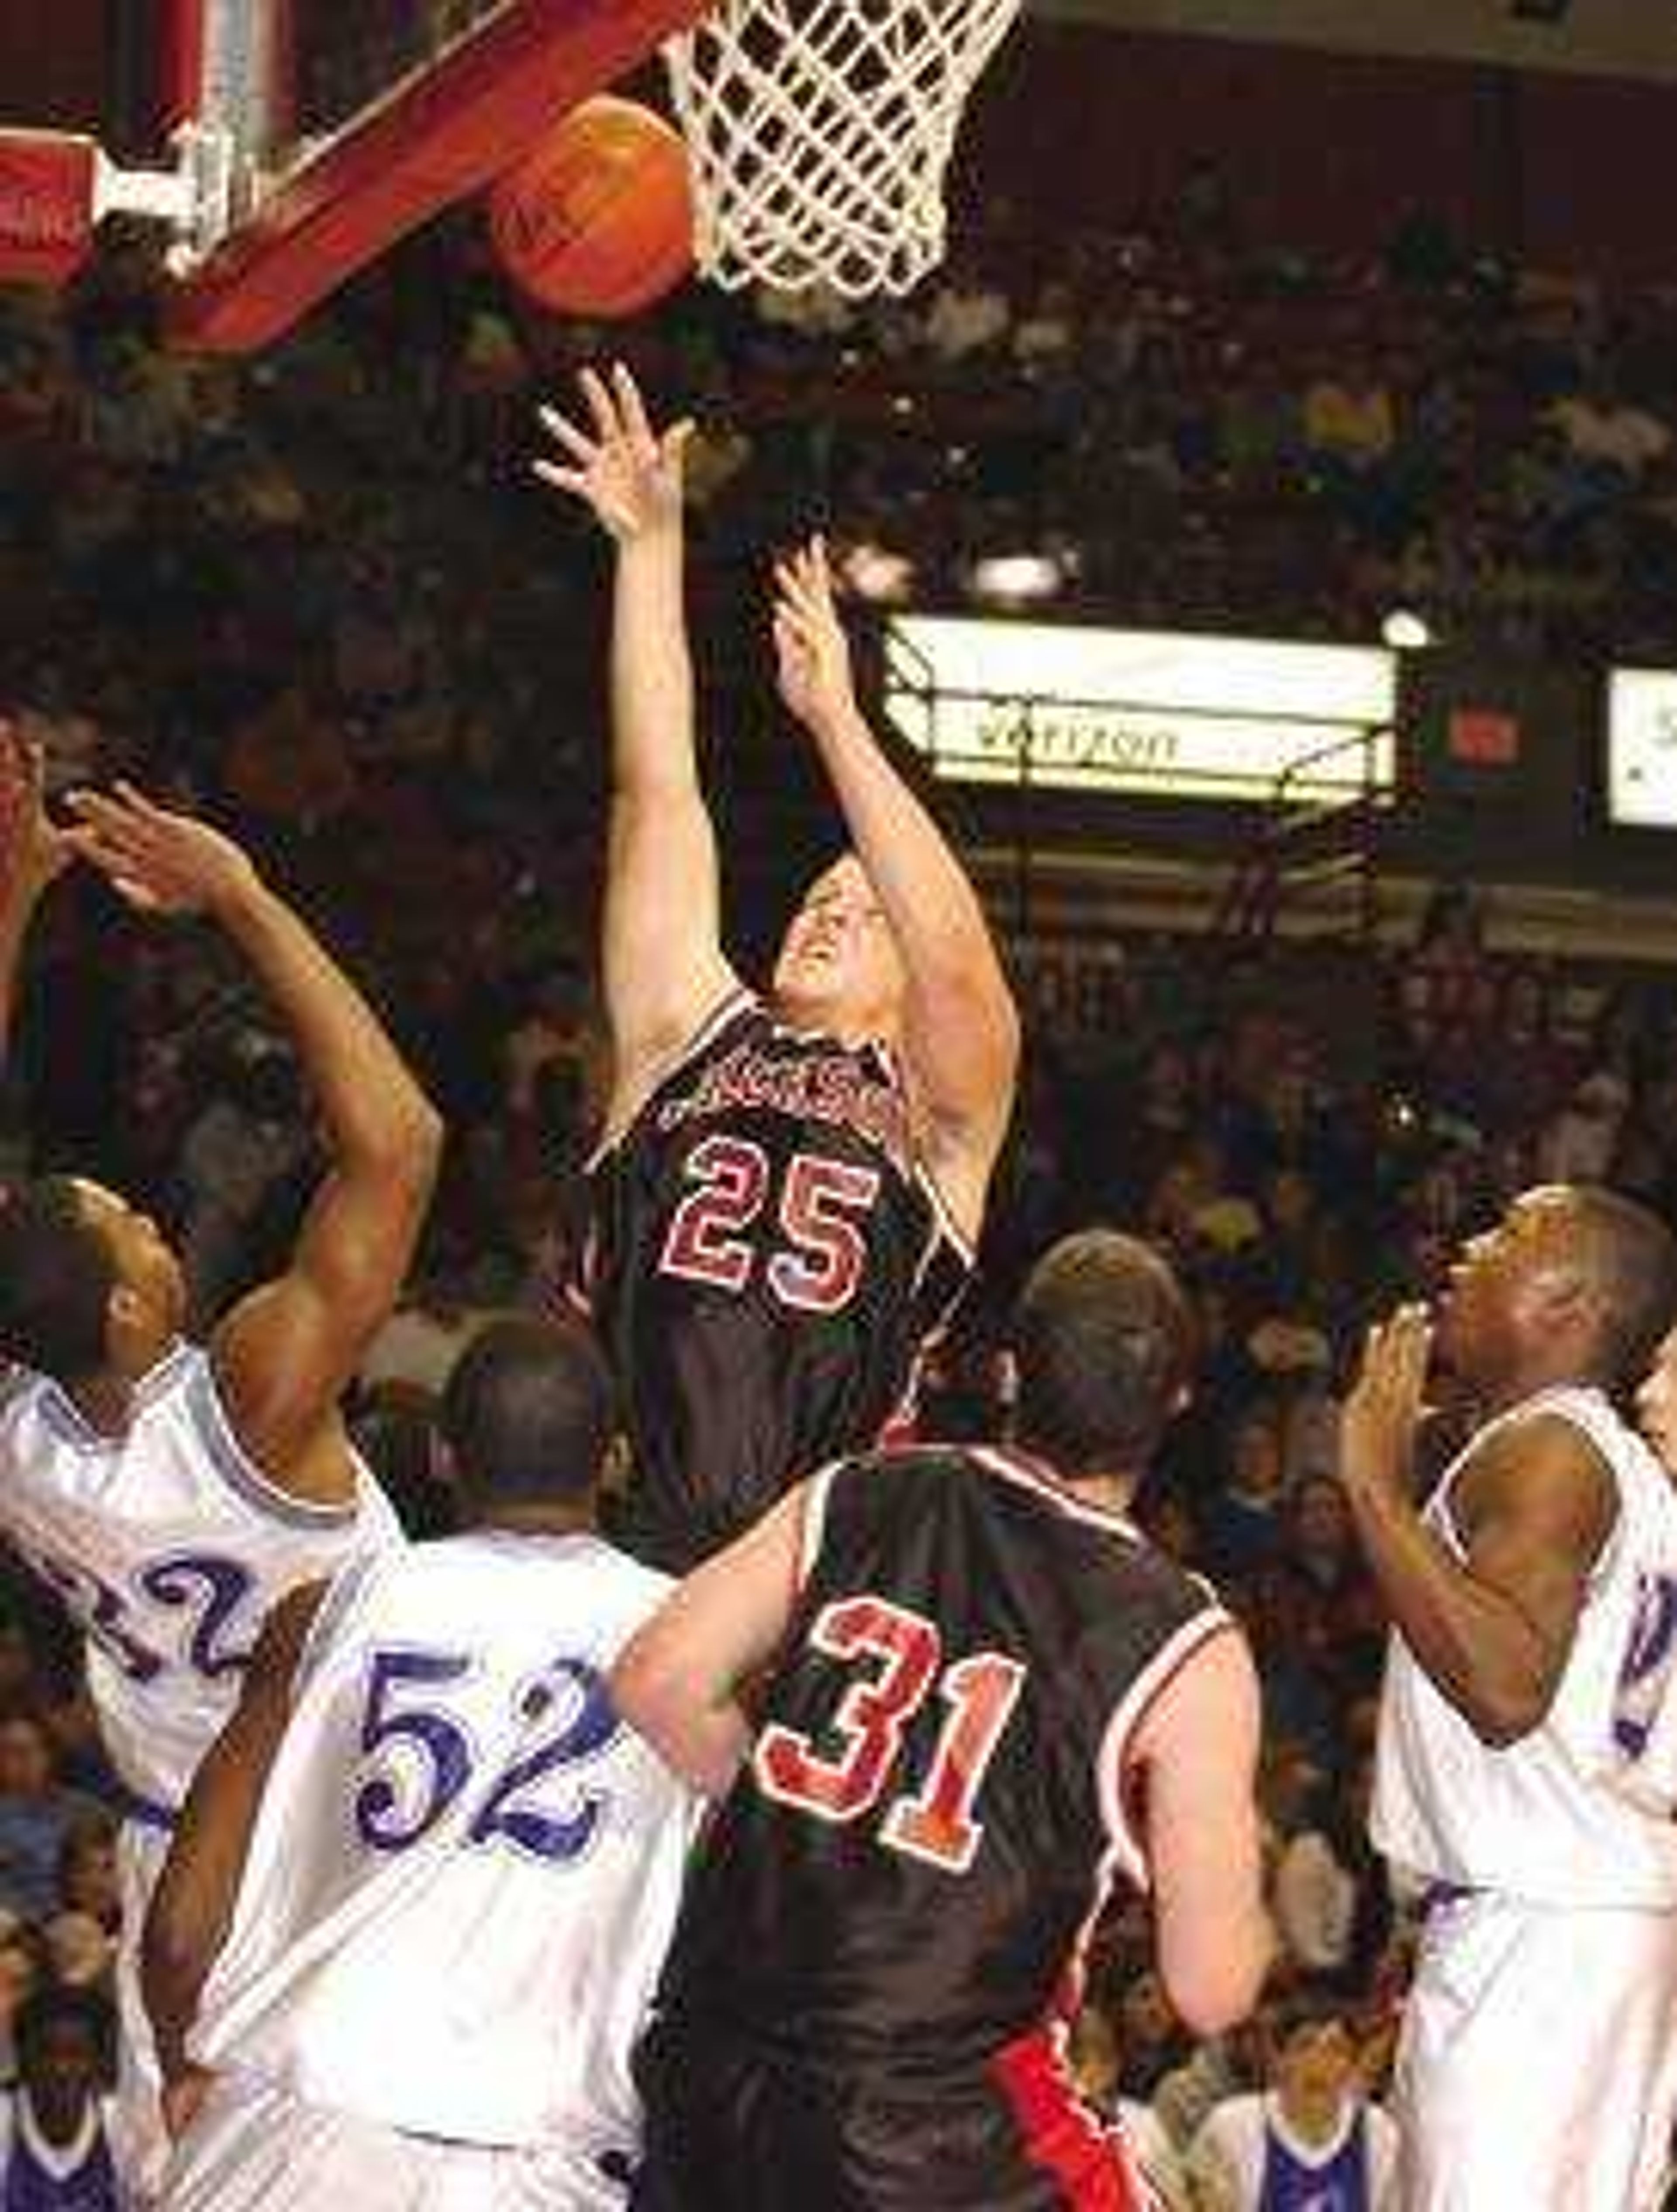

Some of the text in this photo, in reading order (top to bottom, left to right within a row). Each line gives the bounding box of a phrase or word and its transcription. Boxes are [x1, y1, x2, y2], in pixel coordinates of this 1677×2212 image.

[656, 1136, 880, 1312] 25
[356, 1651, 621, 1860] 52
[755, 1595, 1027, 1875] 31
